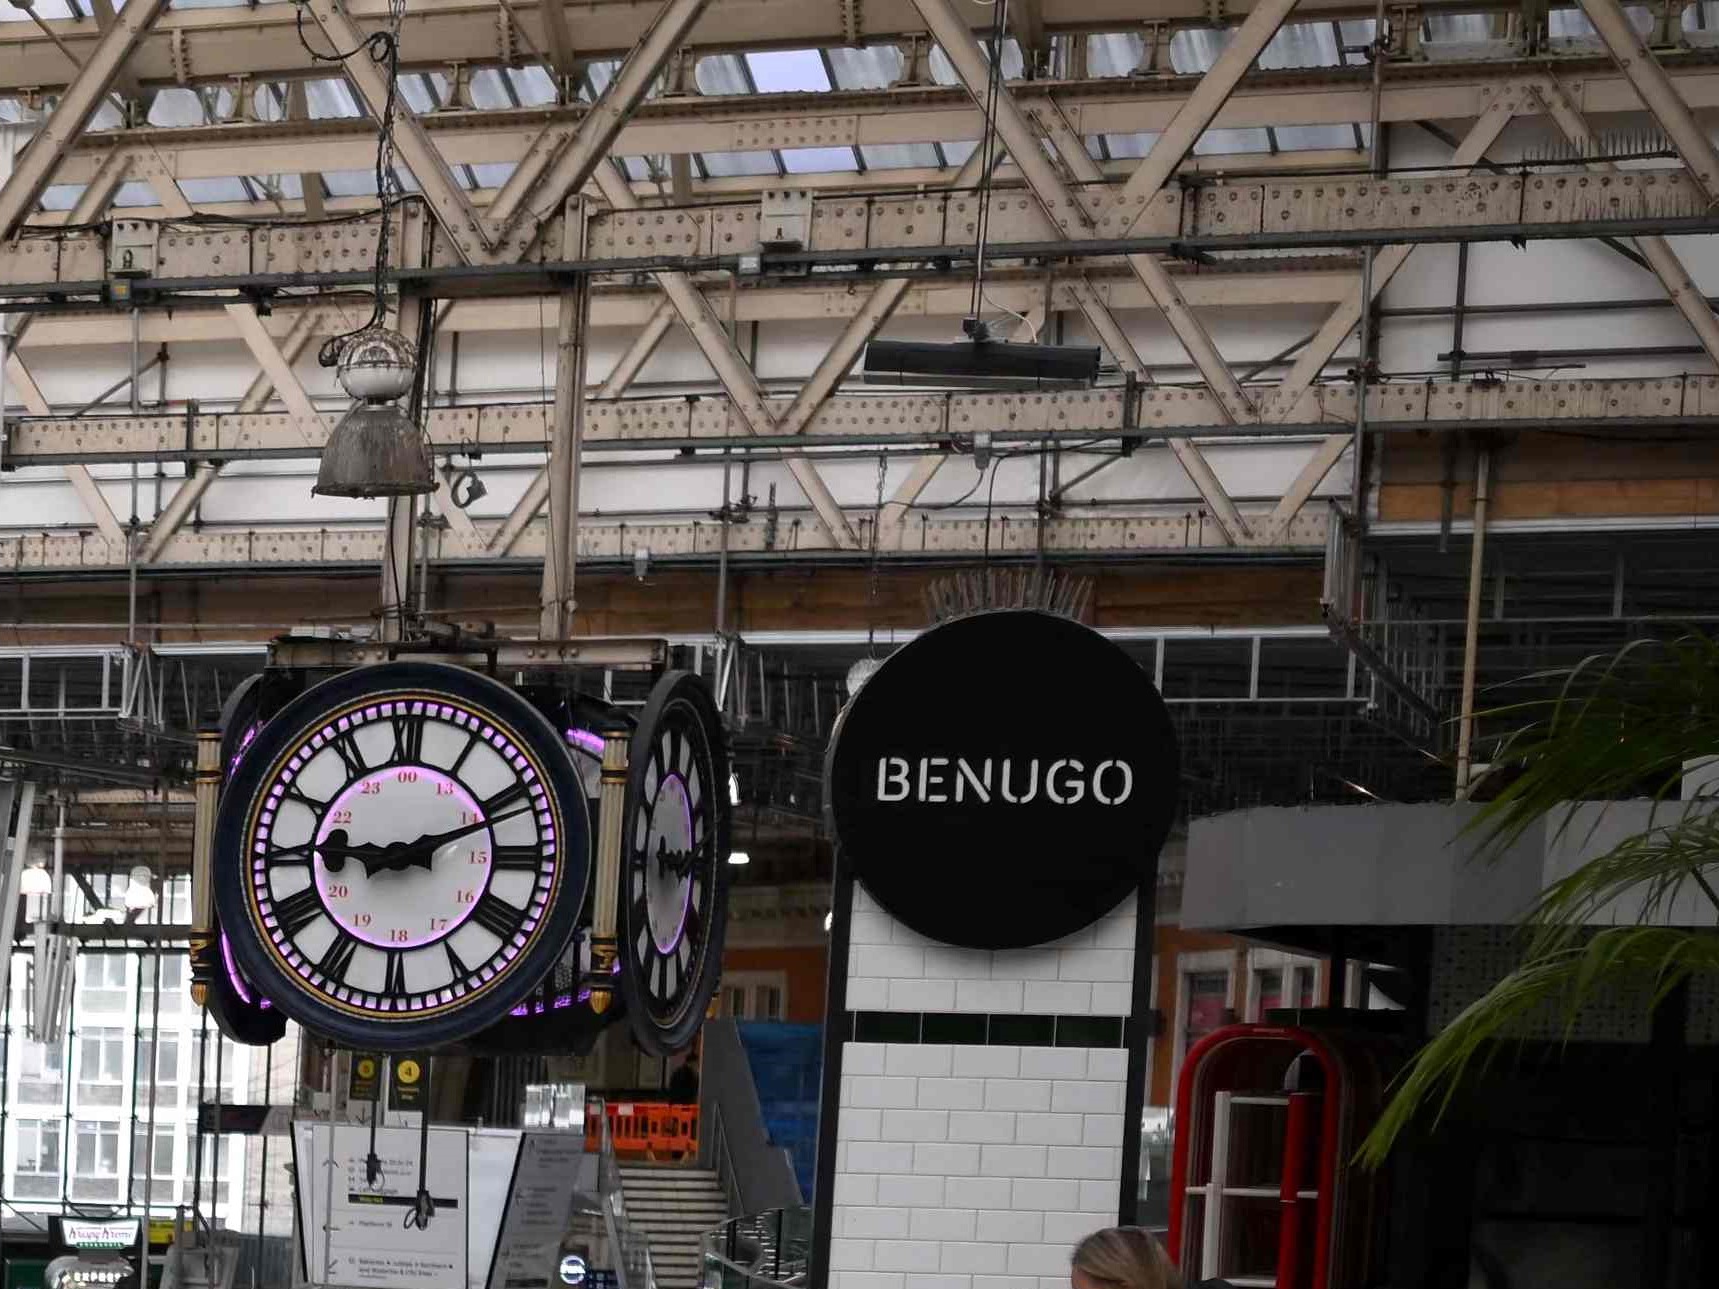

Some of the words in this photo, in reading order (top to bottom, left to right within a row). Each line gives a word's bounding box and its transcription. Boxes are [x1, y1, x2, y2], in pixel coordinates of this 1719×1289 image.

[398, 770, 418, 784] 00
[877, 755, 1134, 807] BENUGO
[361, 780, 381, 795] 23
[435, 782, 454, 796] 13
[333, 811, 352, 825] 22
[470, 851, 489, 865] 15
[328, 885, 349, 899] 20
[456, 890, 475, 905] 16
[353, 913, 373, 928] 19
[429, 918, 449, 932] 17
[389, 929, 409, 943] 18
